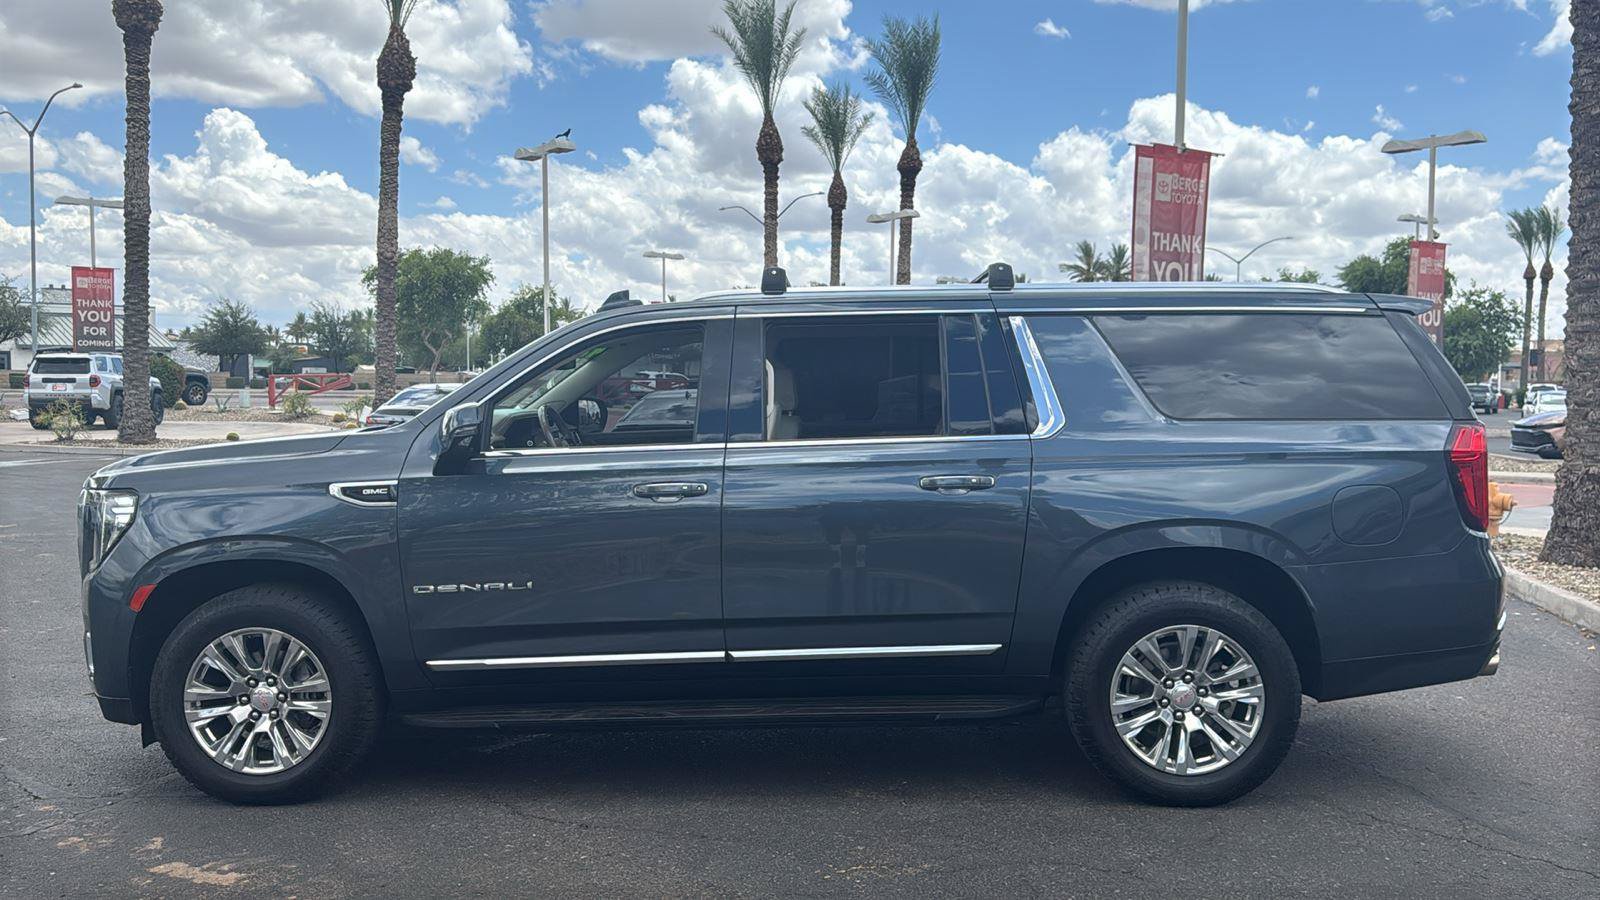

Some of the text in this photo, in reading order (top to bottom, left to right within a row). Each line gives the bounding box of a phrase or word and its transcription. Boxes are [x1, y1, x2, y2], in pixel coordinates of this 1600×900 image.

[1171, 173, 1205, 193] BERGE
[1171, 192, 1202, 205] TOYOTA
[1152, 231, 1202, 254] THANK
[1152, 260, 1199, 282] YOU
[76, 299, 112, 308] THANK
[78, 310, 111, 322] YOU
[83, 326, 107, 336] FOR
[362, 487, 388, 495] GMC
[413, 581, 533, 594] DENALI
